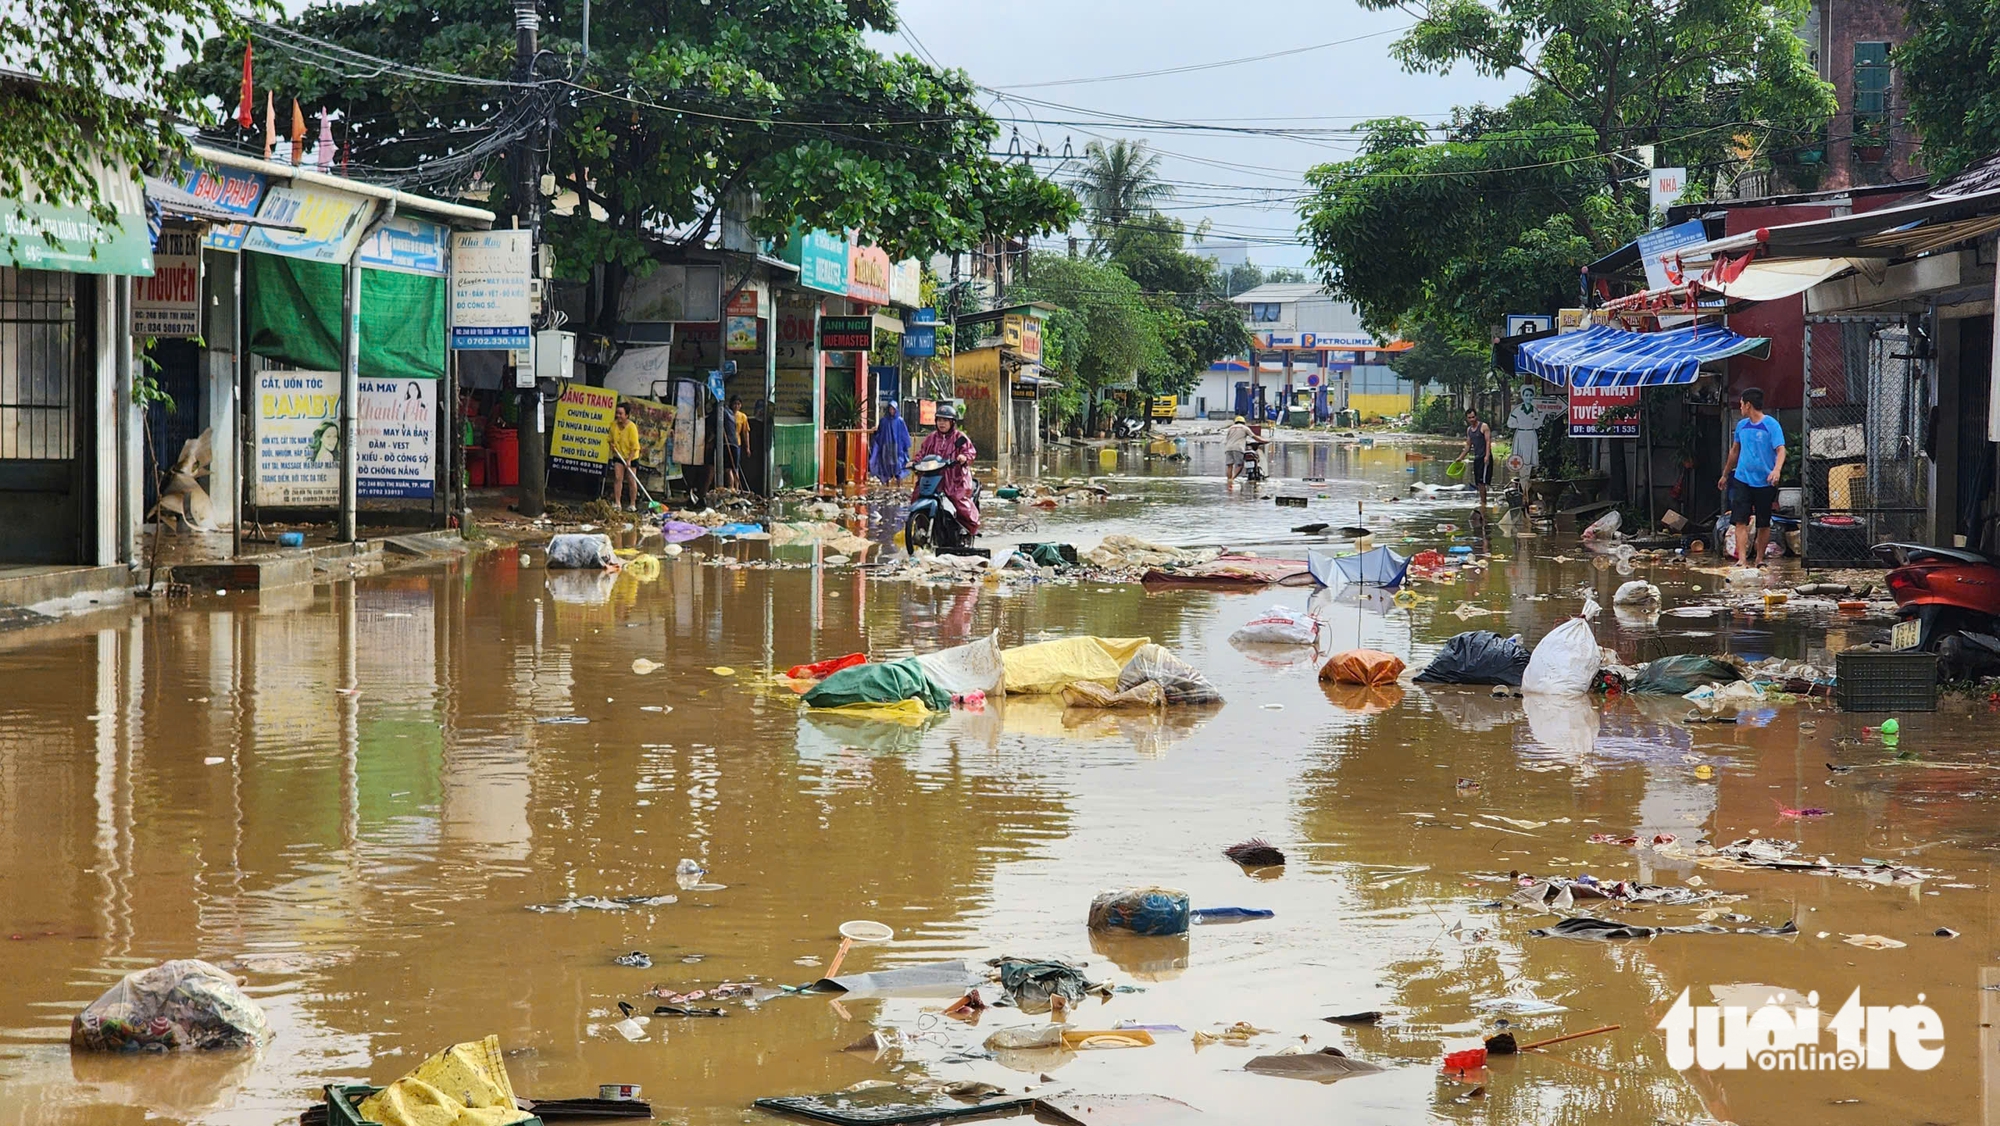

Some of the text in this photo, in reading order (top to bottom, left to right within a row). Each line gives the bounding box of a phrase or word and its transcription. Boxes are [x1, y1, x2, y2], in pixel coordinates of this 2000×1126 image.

[221, 173, 260, 209] PHÁP
[148, 261, 196, 302] NGUYÊN
[456, 301, 466, 310] ĐỒ
[468, 301, 486, 310] CÔNG
[148, 322, 162, 333] 034
[182, 324, 196, 334] 774
[824, 321, 844, 330] ANH
[466, 338, 526, 346] 0702.330.131
[823, 334, 870, 347] HUEMASTER
[903, 336, 916, 349] THAY
[262, 375, 323, 390] CẮT, UỐN TÓC
[376, 383, 398, 392] MAY
[262, 393, 340, 420] BAMBY
[586, 393, 614, 410] TRANG
[568, 409, 590, 418] CHUYÊN
[383, 428, 400, 436] MAY
[402, 428, 412, 437] VÀ
[413, 428, 428, 438] BÁN
[566, 422, 582, 432] NHỰA
[594, 426, 610, 434] LOAN
[368, 439, 410, 450] ĐẦM VEST
[574, 436, 587, 445] HỌC
[588, 438, 602, 446] SINH
[362, 450, 378, 462] KIỂU
[384, 452, 395, 462] ĐỒ
[396, 452, 417, 462] CÔNG
[560, 446, 600, 459] THEO YÊU CẦU
[280, 462, 302, 470] MASSAGE
[358, 464, 420, 476] ĐỒ CHỐNG NẮNG
